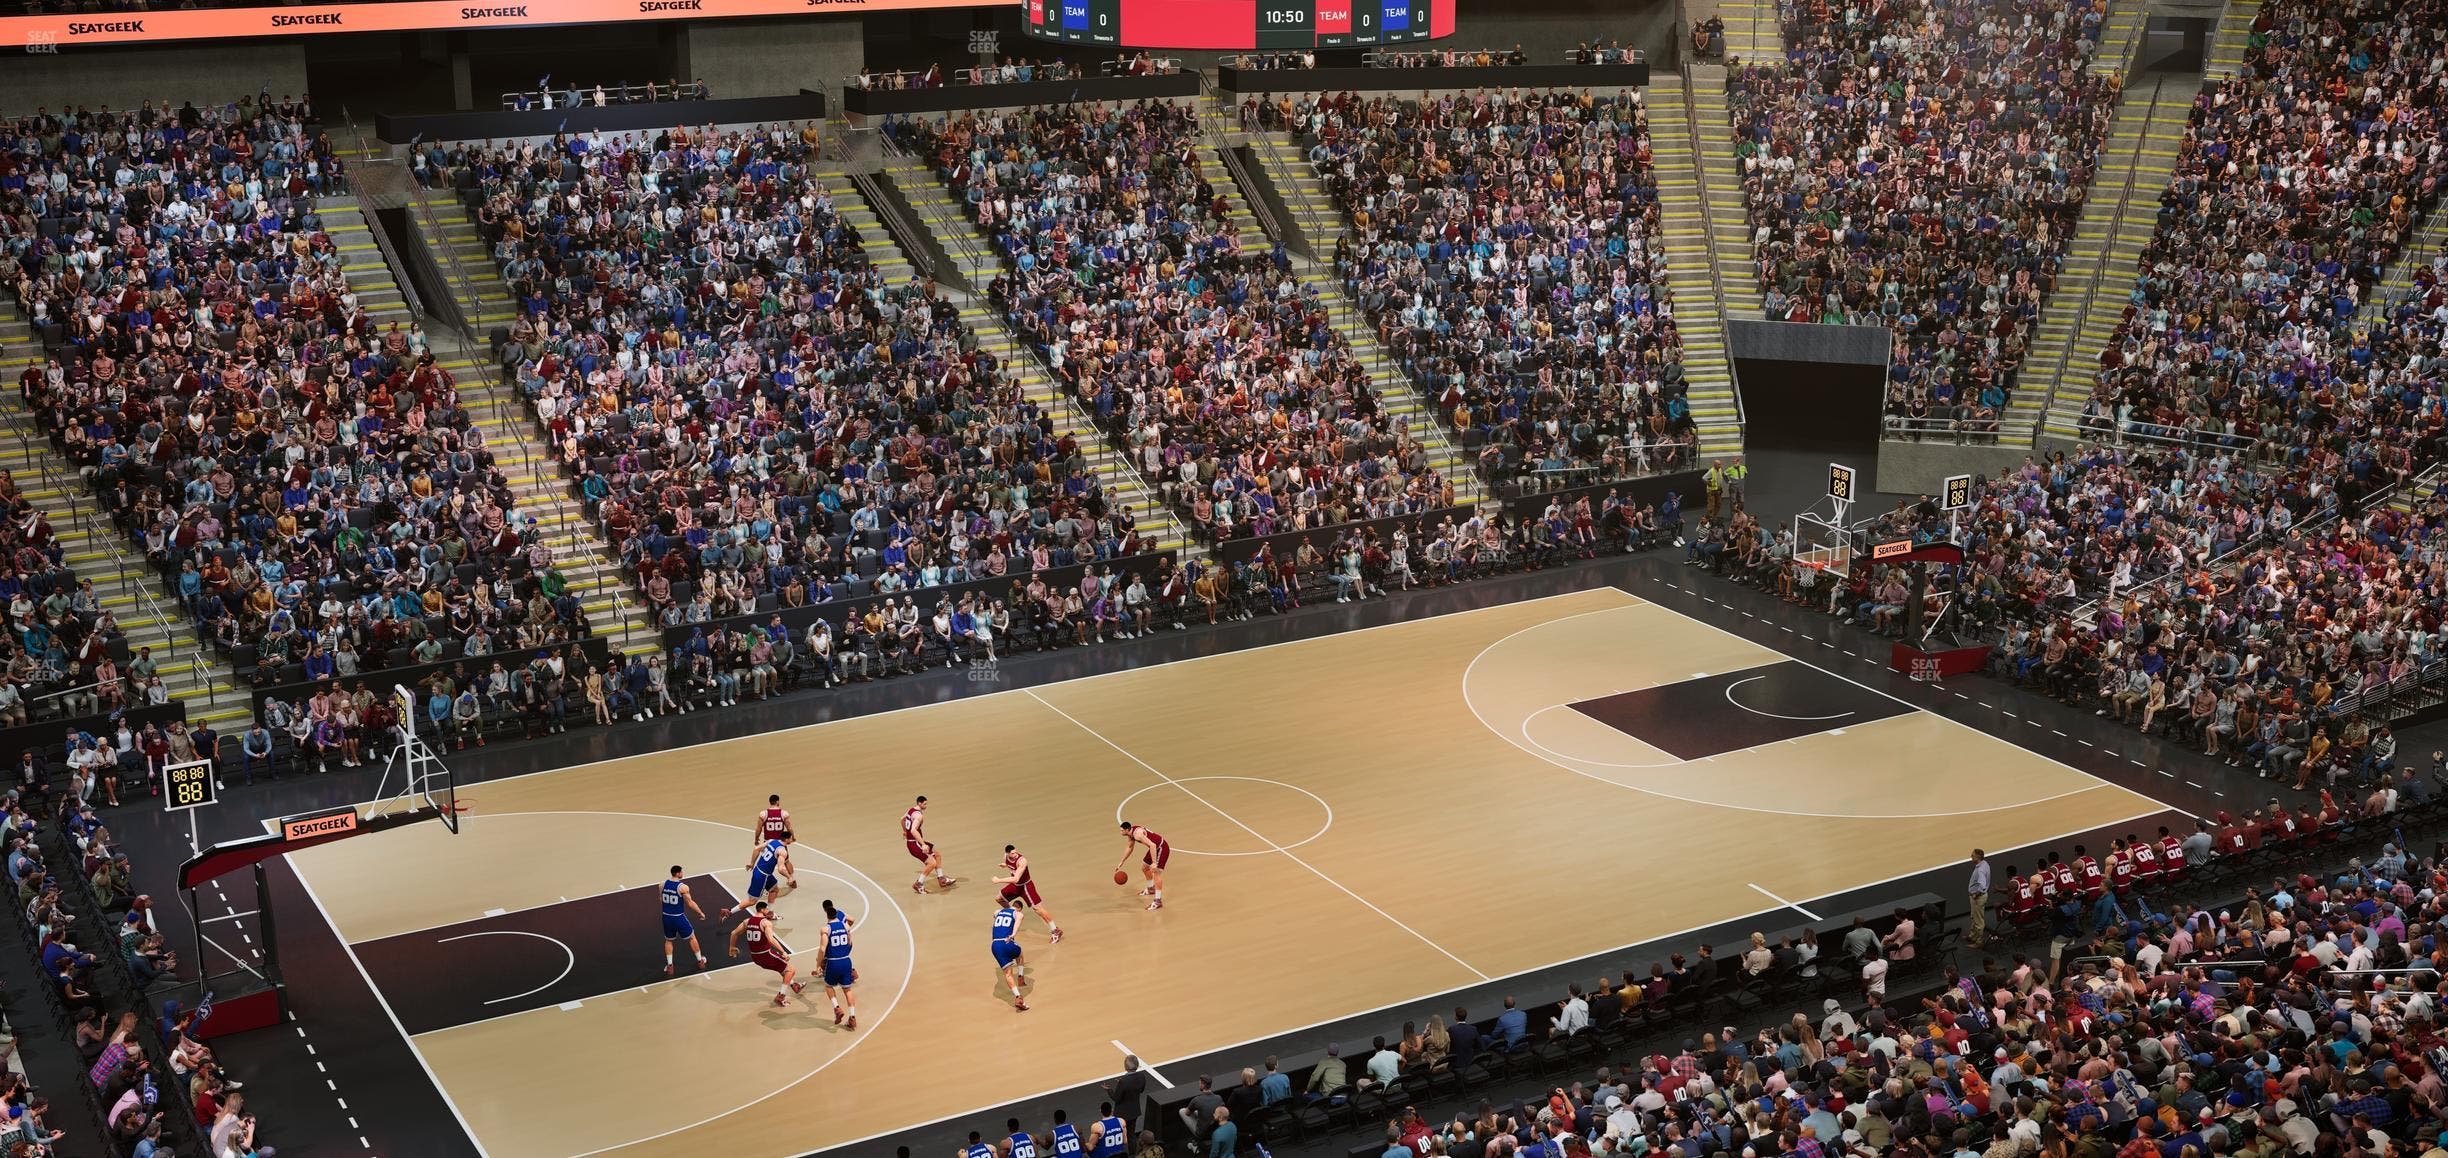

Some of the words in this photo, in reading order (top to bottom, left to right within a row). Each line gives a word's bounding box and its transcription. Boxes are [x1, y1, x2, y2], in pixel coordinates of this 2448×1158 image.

[461, 6, 528, 20] SEATGEEK
[639, 0, 702, 12] SEATGEEK
[271, 13, 343, 27] SEATGEEK
[1064, 7, 1085, 17] TEAM
[1100, 14, 1107, 26] 0
[1265, 10, 1304, 23] 10:50
[1320, 11, 1347, 21] TEAM
[1362, 14, 1370, 27] 0
[1385, 8, 1407, 18] TEAM
[1417, 10, 1424, 23] 0
[68, 20, 145, 35] SEATGEEK
[1833, 479, 1847, 497] 88
[1951, 490, 1965, 506] 88
[1878, 543, 1908, 556] SEATGEEK
[172, 770, 188, 783] 88
[189, 766, 204, 780] 88
[178, 781, 203, 804] 88
[292, 816, 350, 836] SEATGEEK
[766, 821, 783, 832] 00
[2135, 848, 2155, 863] 00
[2166, 847, 2183, 860] 00
[2086, 865, 2101, 877] 00
[2117, 864, 2131, 876] 00
[2060, 872, 2075, 885] 00
[662, 893, 679, 905] 00
[994, 915, 1012, 928] 00
[746, 930, 761, 942] 00
[830, 934, 848, 947] 00
[1057, 1137, 1080, 1154] 00
[1105, 1133, 1124, 1148] 00
[1014, 1145, 1036, 1158] 00
